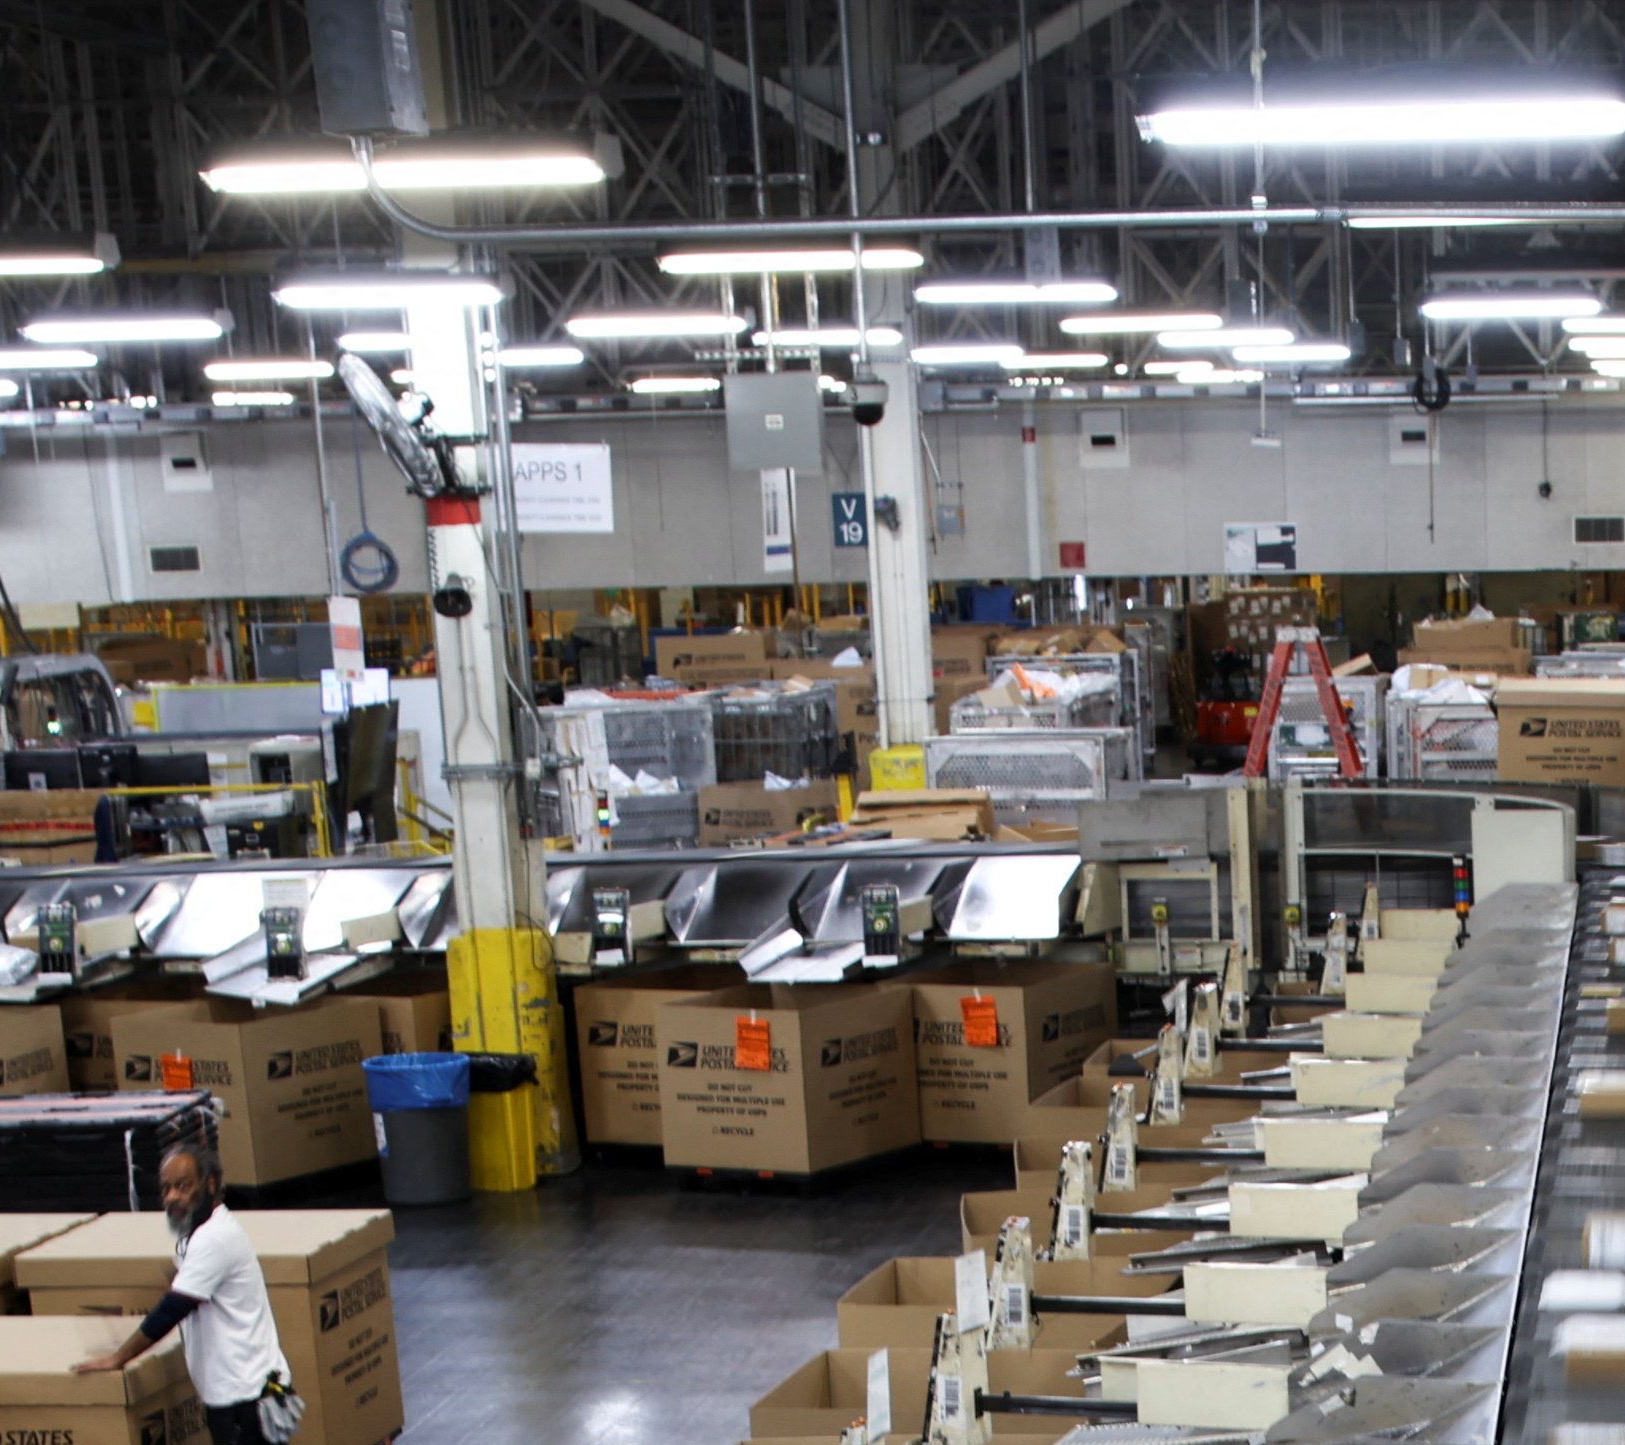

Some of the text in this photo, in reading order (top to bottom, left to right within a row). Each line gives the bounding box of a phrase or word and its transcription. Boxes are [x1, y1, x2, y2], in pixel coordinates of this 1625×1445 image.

[514, 462, 583, 482] APPS 1
[841, 498, 856, 520] V
[840, 523, 864, 545] 19
